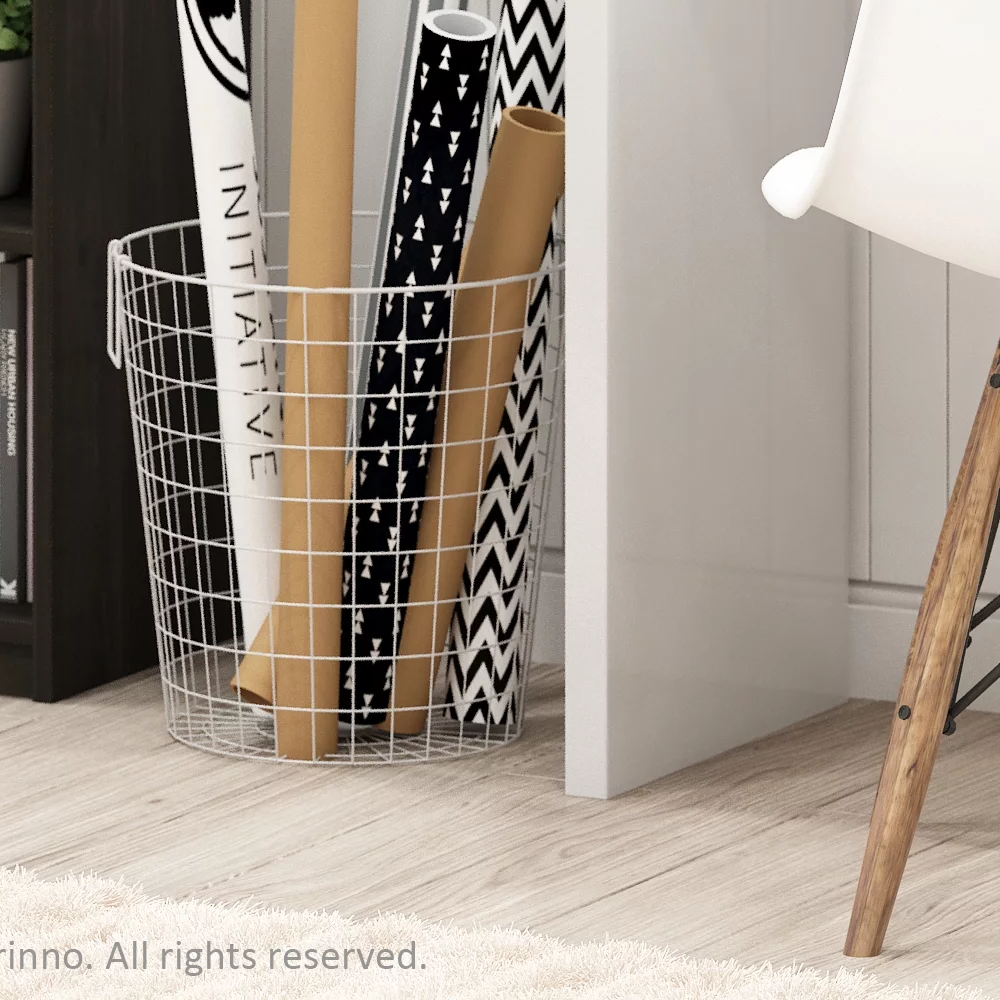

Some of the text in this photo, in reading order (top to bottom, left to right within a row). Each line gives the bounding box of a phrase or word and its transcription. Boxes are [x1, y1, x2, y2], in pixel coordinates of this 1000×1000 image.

[6, 329, 17, 457] NEW URBAN HOUSING
[219, 163, 278, 480] INITIATIVE
